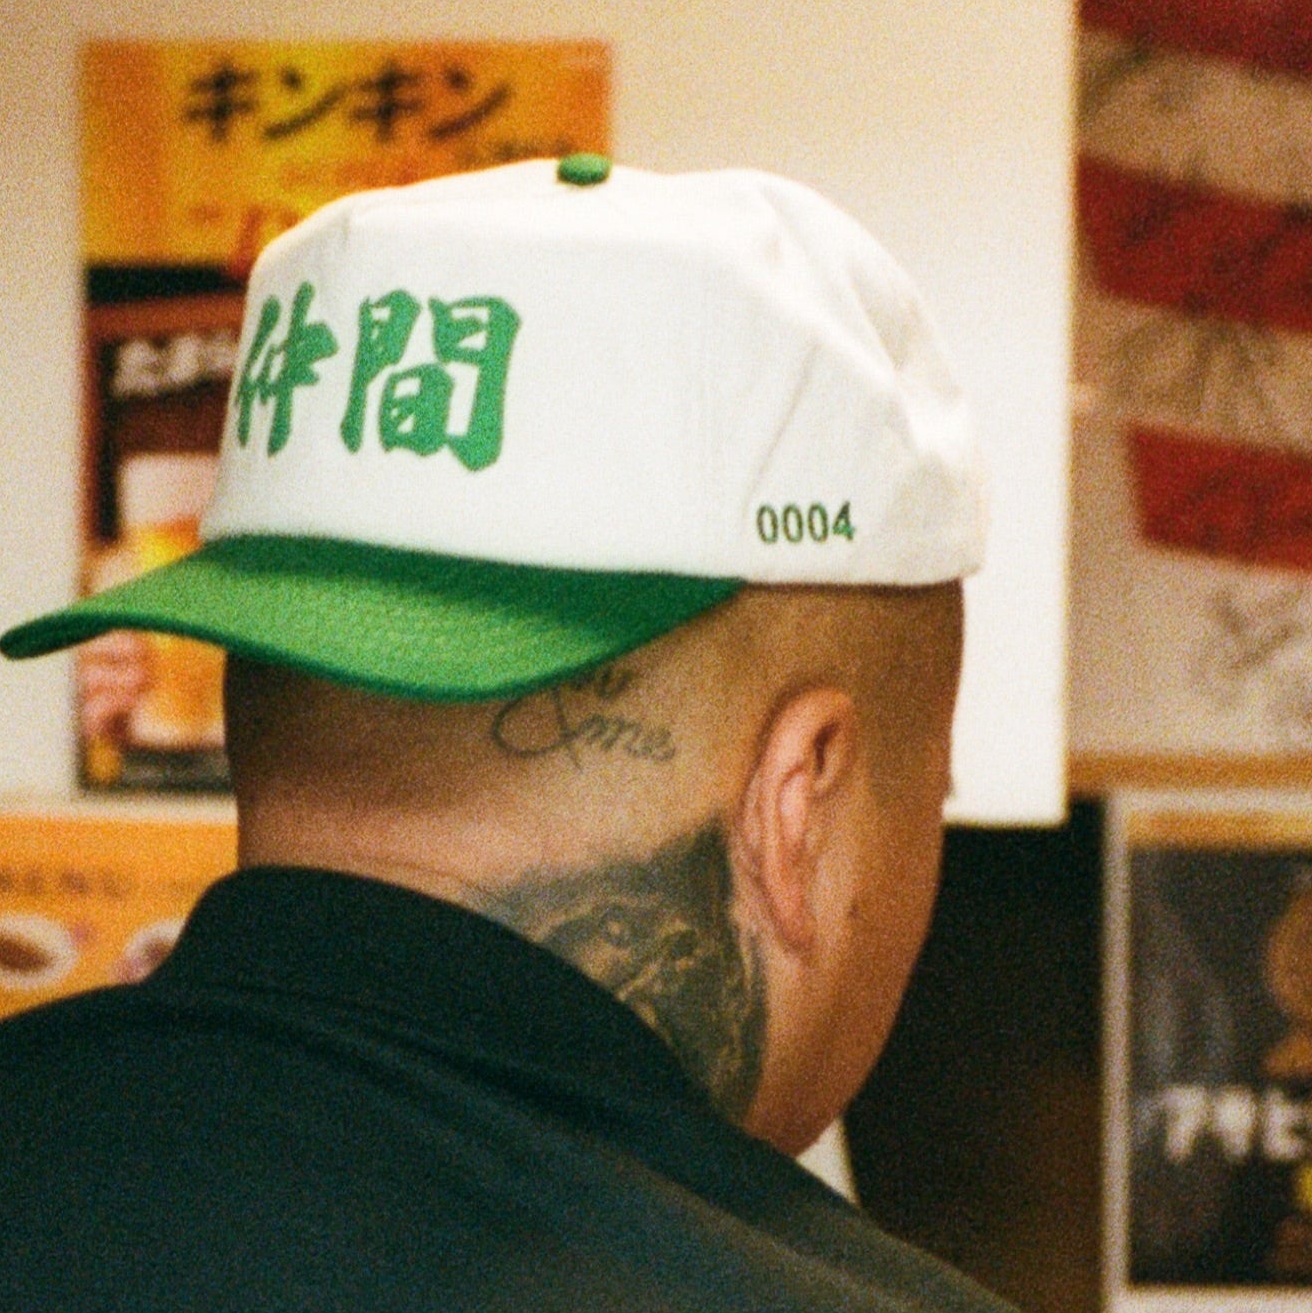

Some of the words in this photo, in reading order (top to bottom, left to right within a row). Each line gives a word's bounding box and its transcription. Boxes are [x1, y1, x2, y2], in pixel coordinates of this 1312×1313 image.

[182, 55, 509, 145] キンキン
[233, 281, 522, 473] 仲間
[753, 501, 856, 545] 0004
